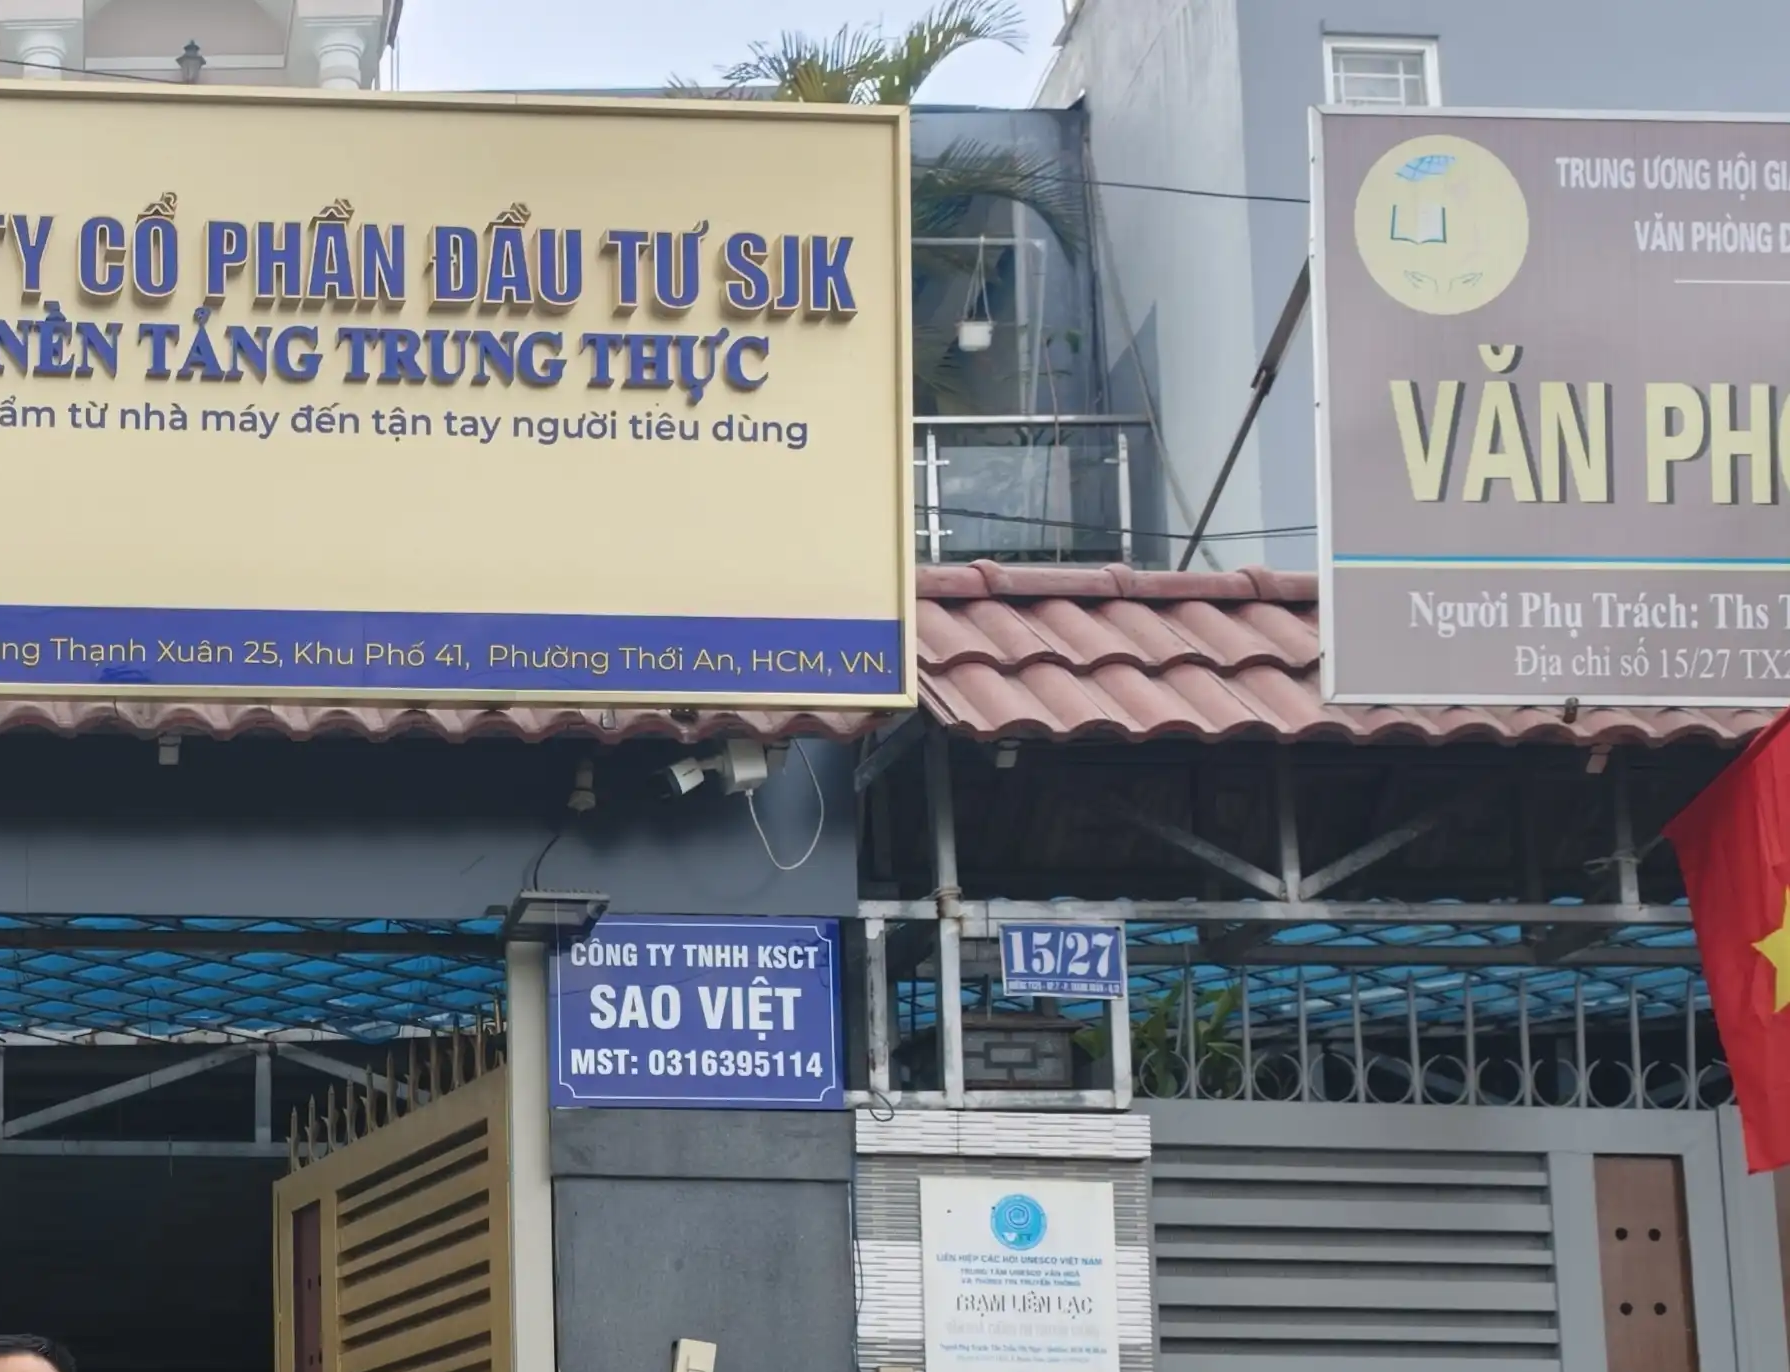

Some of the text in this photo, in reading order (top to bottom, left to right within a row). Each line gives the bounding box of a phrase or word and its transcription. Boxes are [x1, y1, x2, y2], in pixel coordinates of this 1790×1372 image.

[1556, 150, 1790, 202] TRUNG ƯƠNG HỘI GI
[76, 191, 179, 300] CỔ
[202, 198, 407, 311] PHẦN
[426, 202, 584, 315] ĐẦU
[599, 218, 710, 318] TƯ
[718, 231, 859, 323] SJK
[1635, 215, 1684, 252] VĂN
[1691, 214, 1773, 254] PHÒNG
[136, 307, 323, 383] TẢNG
[335, 327, 567, 390] TRUNG
[580, 326, 770, 406] THỰC
[67, 400, 109, 430] từ
[119, 400, 188, 433] nhà
[201, 404, 281, 440] máy
[290, 402, 361, 436] đến
[372, 407, 432, 443] tận
[443, 411, 501, 445] tay
[511, 409, 618, 446] người
[628, 411, 701, 442] tiêu
[711, 413, 809, 449] dùng
[1388, 343, 1790, 505] VĂN PH
[1408, 590, 1510, 639] Người
[1517, 592, 1583, 639] Phụ
[1592, 590, 1700, 630] Trách:
[1709, 593, 1769, 630] Ths
[50, 637, 147, 669] Thạnh
[156, 639, 234, 665] Xuân
[243, 641, 284, 670] 25,
[294, 640, 355, 667] Khu
[364, 639, 425, 668] Phố
[434, 643, 471, 672] 41,
[488, 643, 610, 676] Phường
[618, 643, 685, 673] Thới
[692, 647, 742, 677] An,
[751, 649, 832, 676] HCM,
[840, 650, 893, 675] VN.
[1513, 645, 1563, 682] Địa
[1571, 641, 1611, 678] chỉ
[1619, 636, 1650, 679] số
[1659, 646, 1731, 680] 15/27
[570, 937, 820, 970] CÔNG TY TNHH KSCT
[1007, 931, 1114, 978] 15/27
[589, 976, 802, 1041] SAO VIỆT
[570, 1048, 824, 1079] MST: 0316395114
